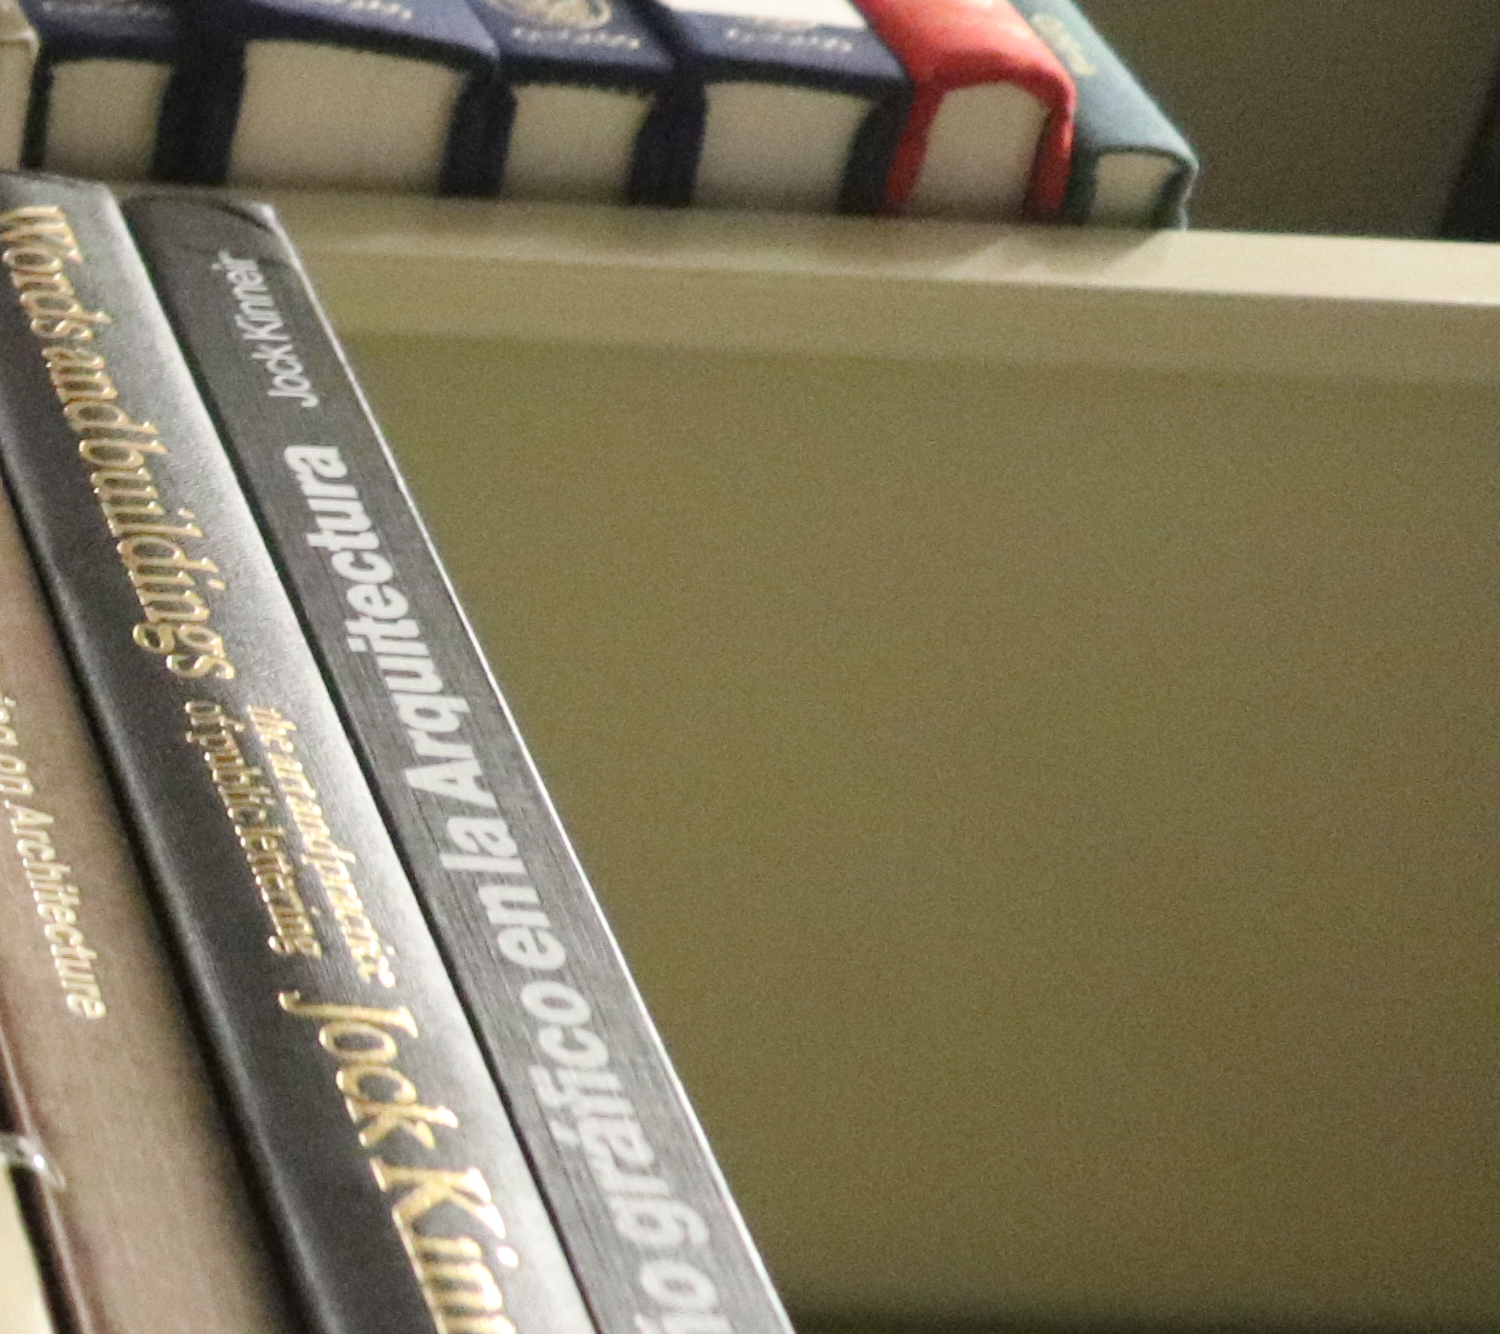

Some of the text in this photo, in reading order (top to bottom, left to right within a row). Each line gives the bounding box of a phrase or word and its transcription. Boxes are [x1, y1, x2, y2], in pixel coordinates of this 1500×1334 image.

[36, 345, 159, 435] and
[209, 248, 321, 408] Jock Kinneir
[58, 436, 259, 681] buildings
[273, 442, 511, 804] Arquitectura
[426, 810, 528, 872] la
[471, 885, 569, 970] en
[275, 991, 474, 1150] Jock
[500, 988, 714, 1250] gráfico
